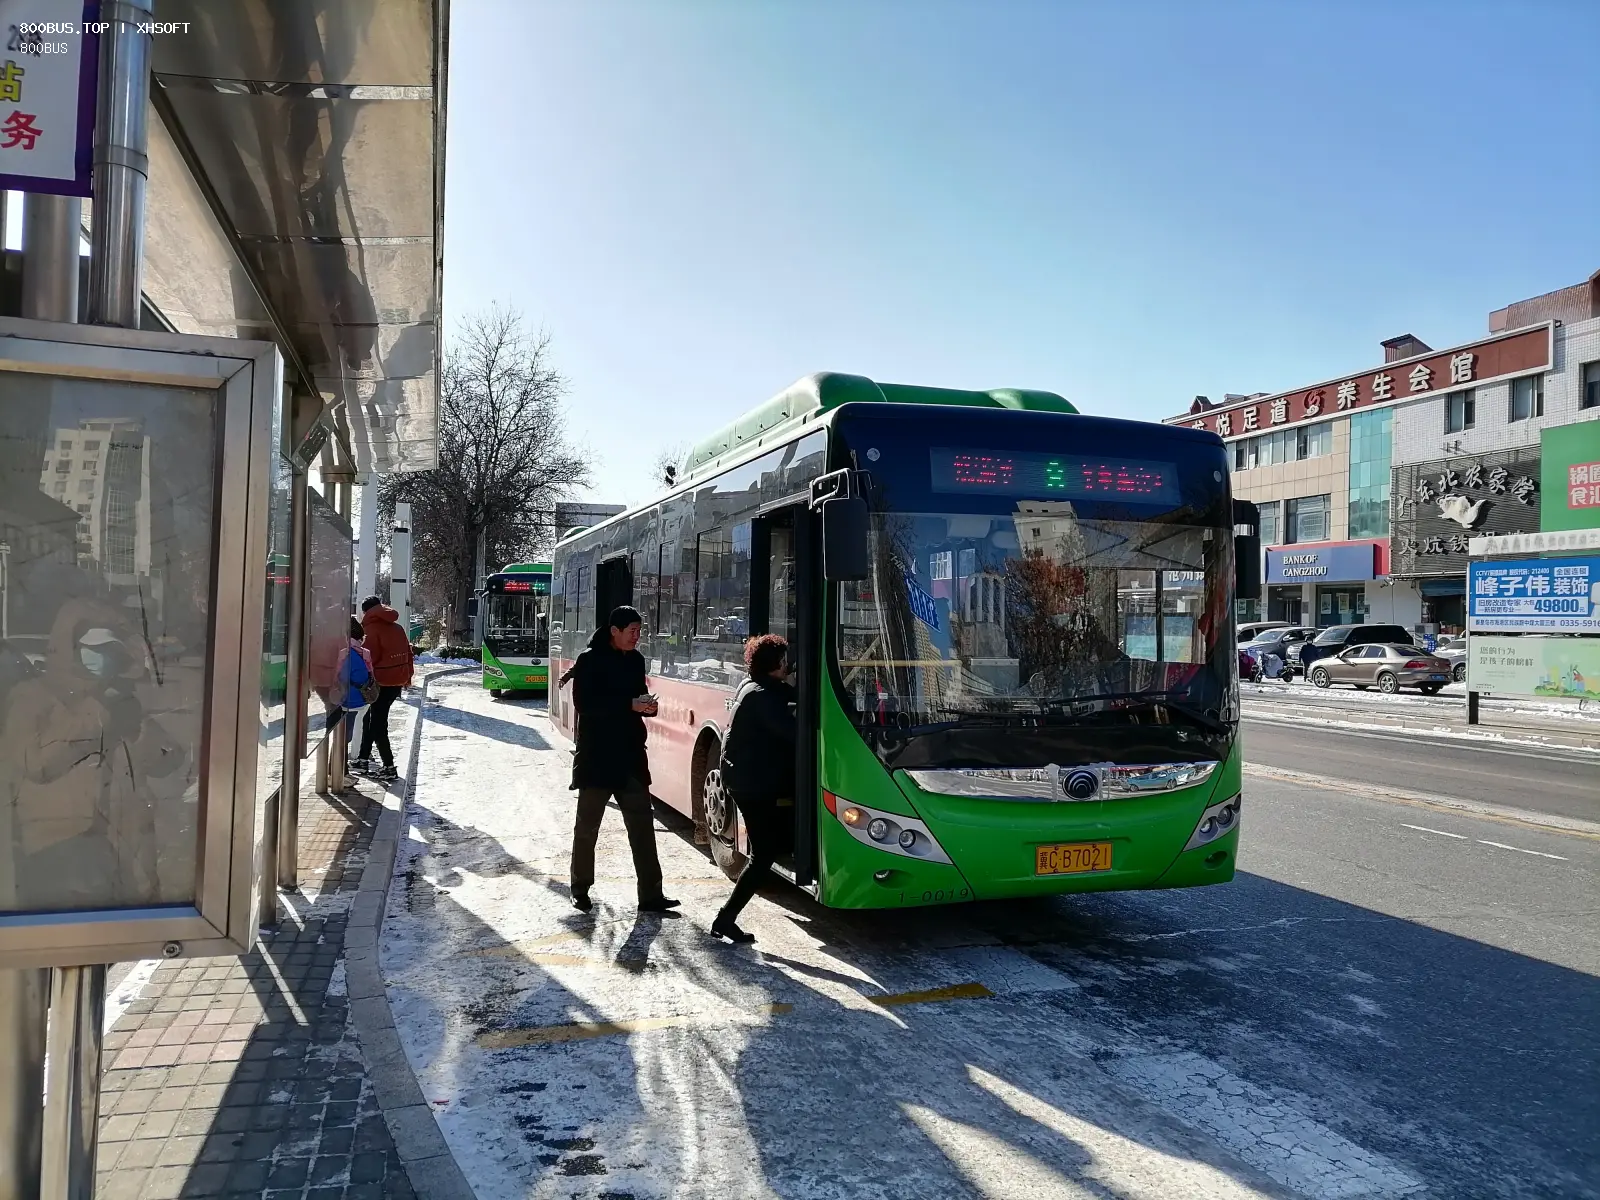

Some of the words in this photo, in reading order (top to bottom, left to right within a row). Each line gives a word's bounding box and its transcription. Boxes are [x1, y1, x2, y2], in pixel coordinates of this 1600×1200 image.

[1337, 352, 1474, 410] 养生会馆
[1282, 566, 1327, 577] CANGZHOU
